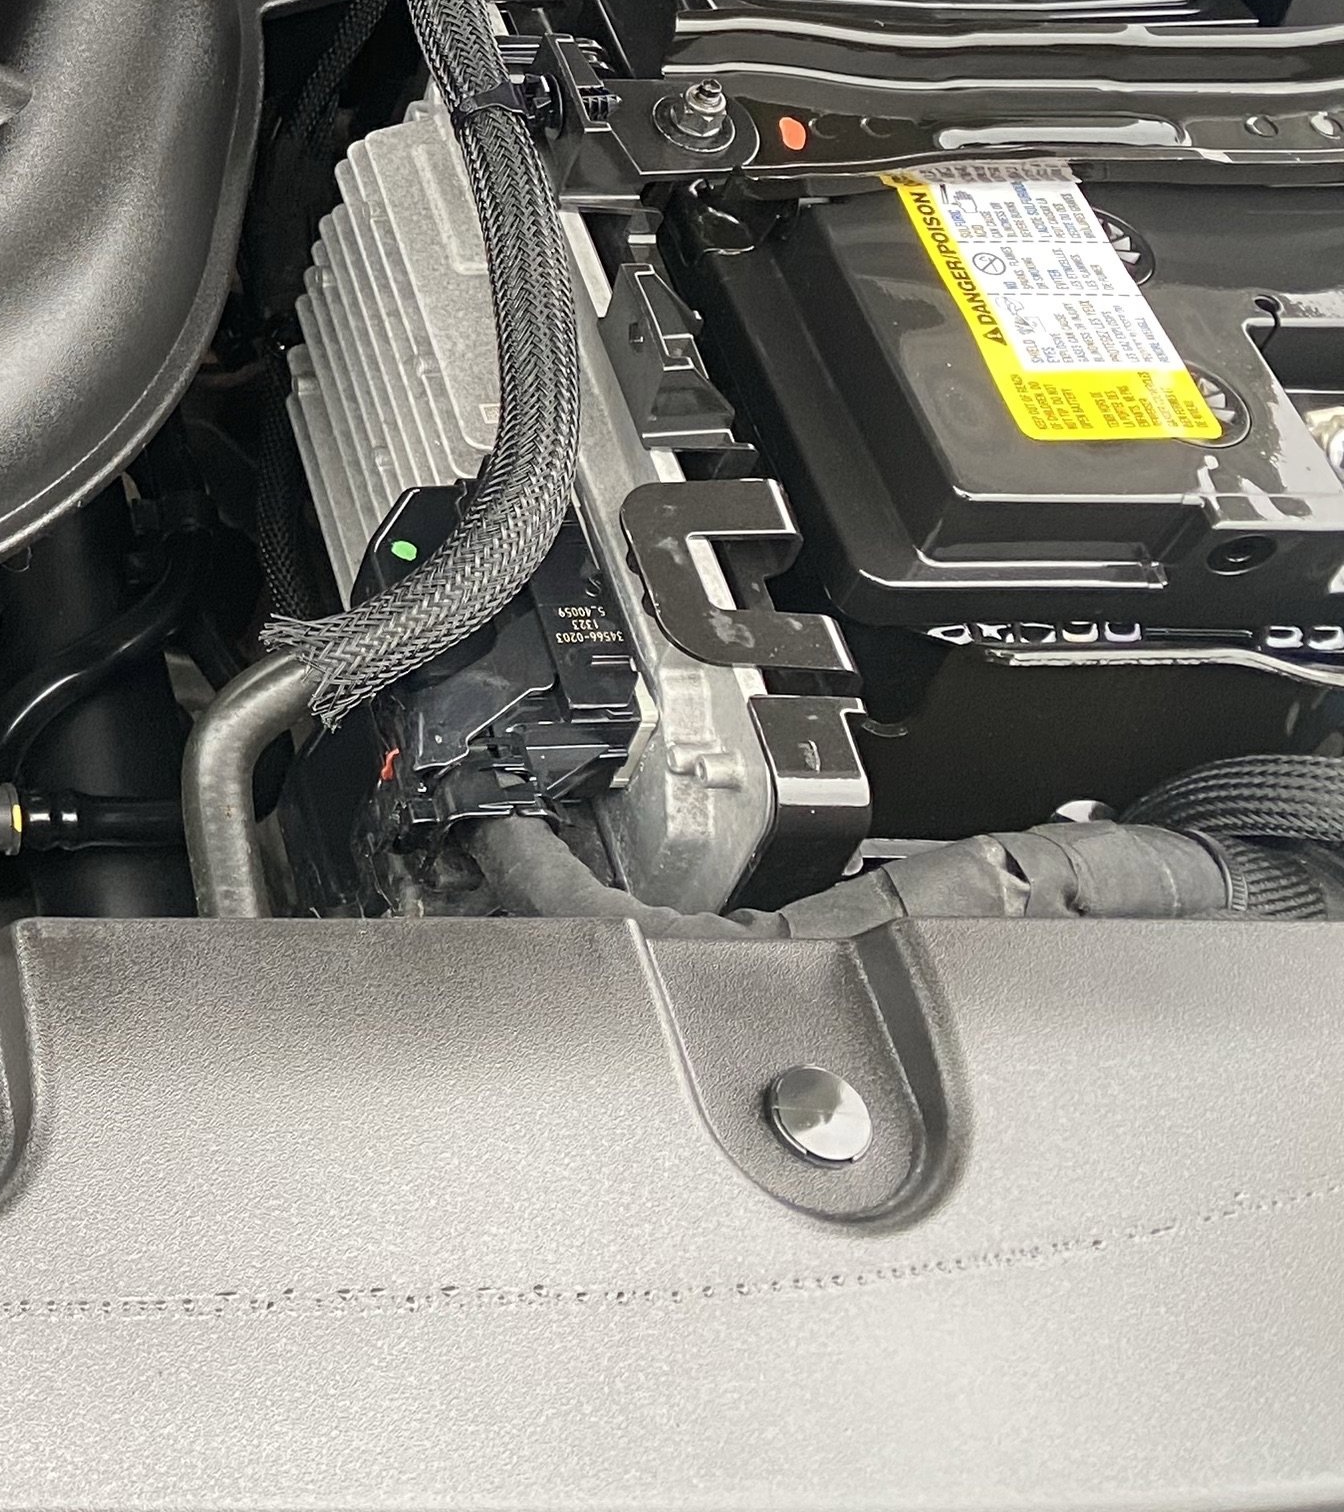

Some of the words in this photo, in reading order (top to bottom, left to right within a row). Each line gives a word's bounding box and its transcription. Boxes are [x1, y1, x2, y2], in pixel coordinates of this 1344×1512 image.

[908, 191, 998, 325] DANGER/POISON
[557, 605, 607, 618] 5_40059
[571, 618, 600, 631] 1323
[555, 630, 625, 645] 34566-0203
